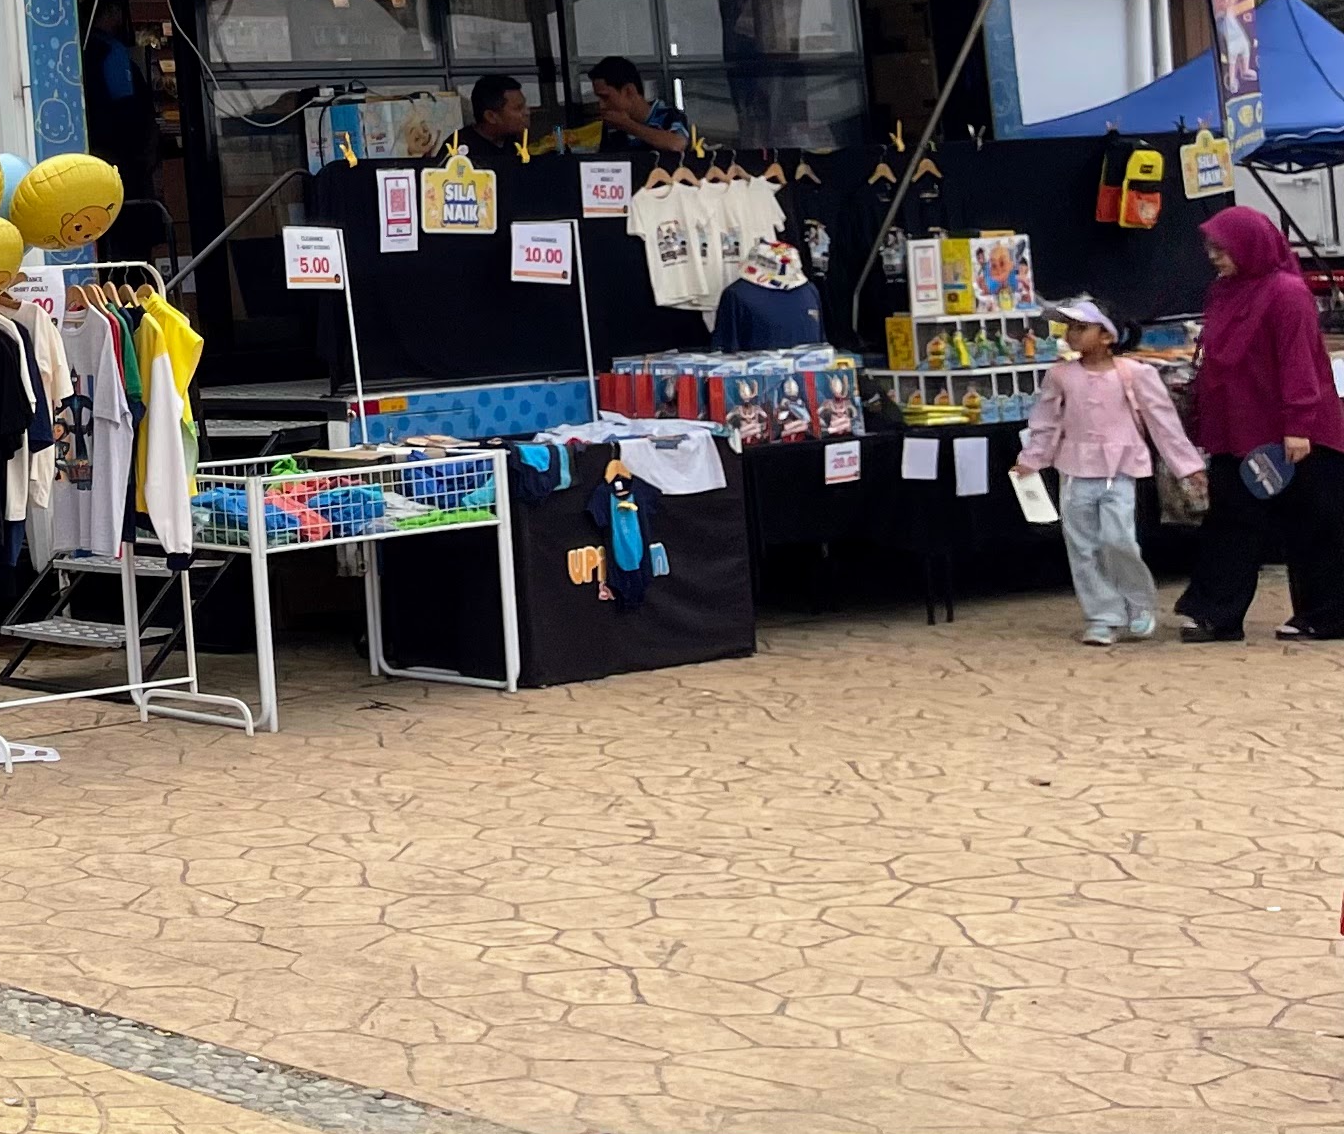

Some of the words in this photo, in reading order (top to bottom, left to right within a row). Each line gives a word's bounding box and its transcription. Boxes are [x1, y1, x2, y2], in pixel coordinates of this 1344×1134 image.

[444, 183, 477, 201] SILA
[592, 184, 625, 200] 45.00
[443, 203, 479, 222] NAIK
[525, 246, 563, 264] 10.00
[299, 256, 330, 274] 5.00
